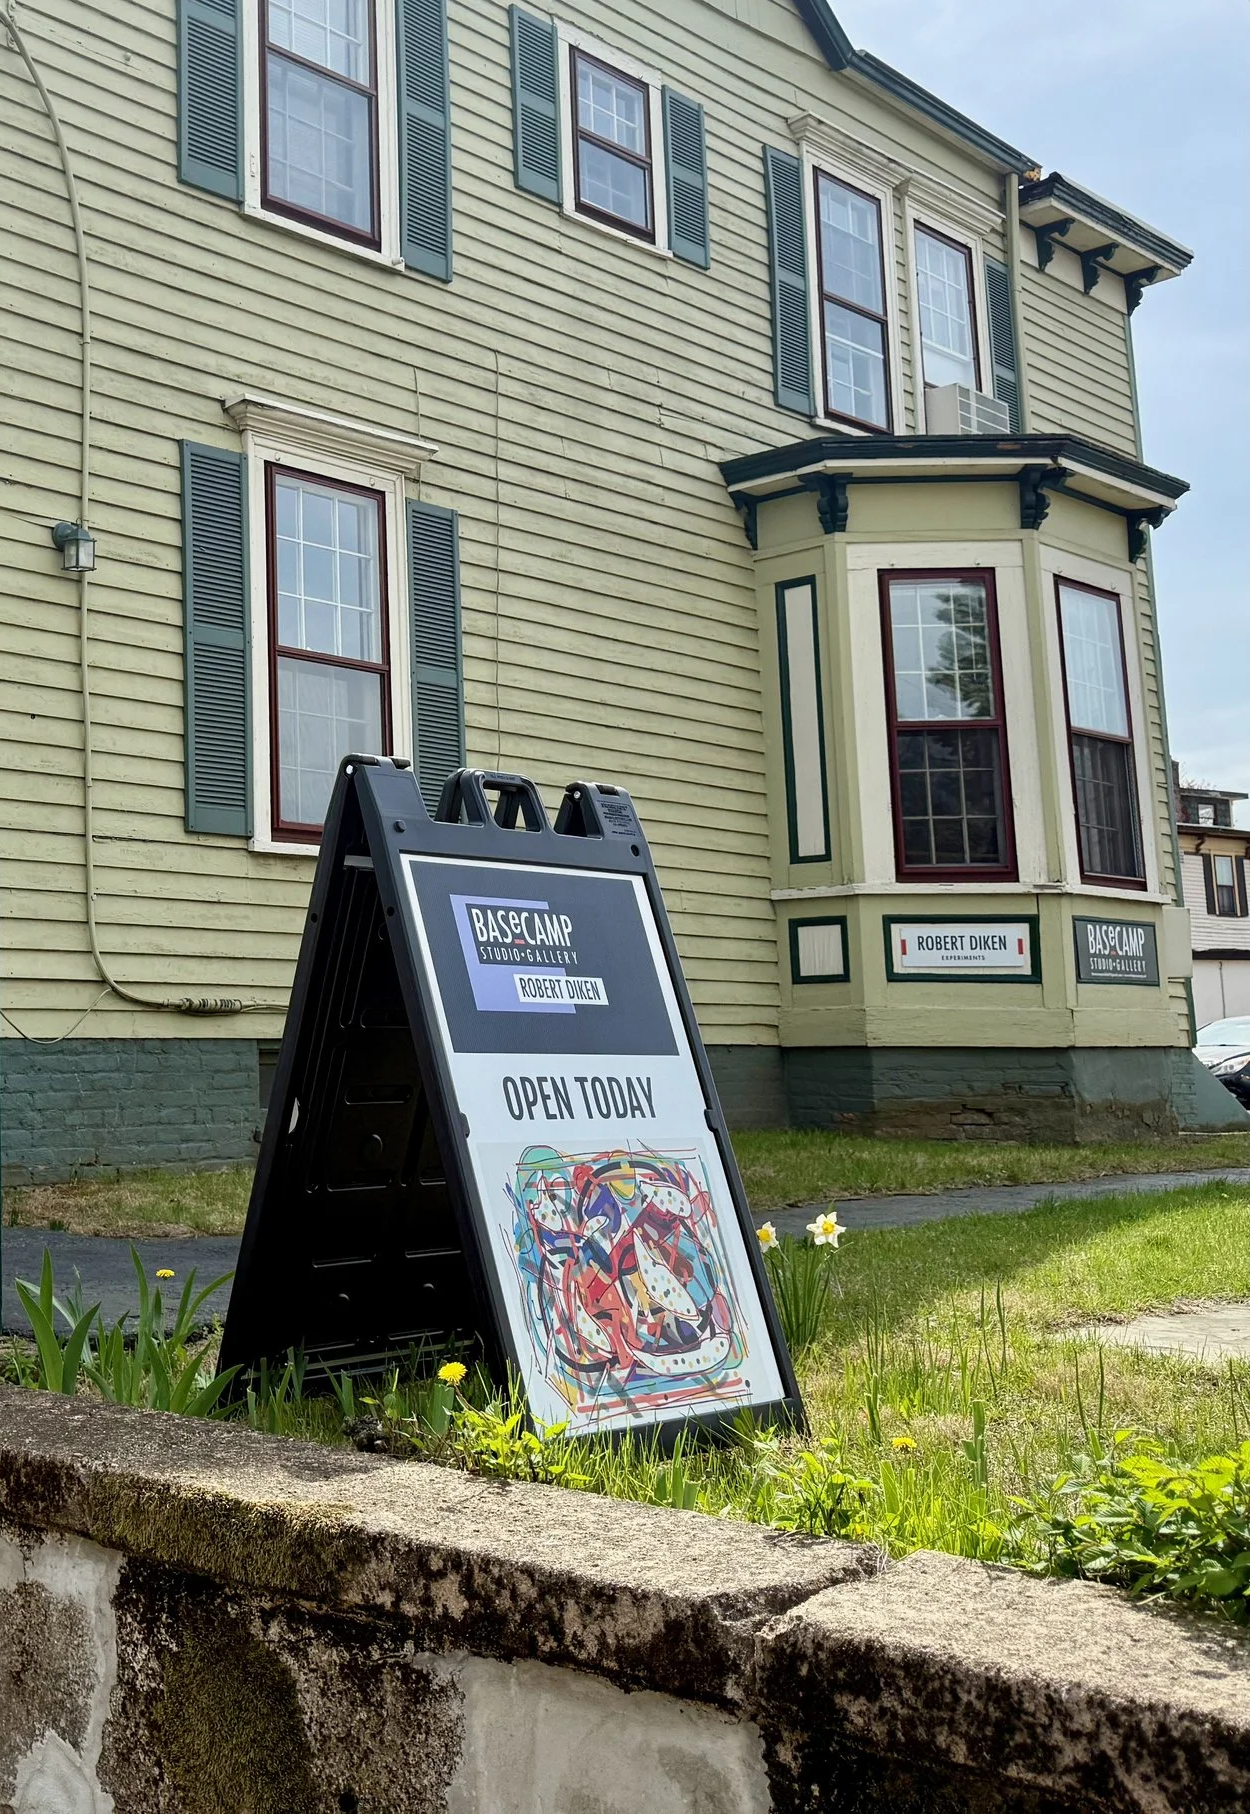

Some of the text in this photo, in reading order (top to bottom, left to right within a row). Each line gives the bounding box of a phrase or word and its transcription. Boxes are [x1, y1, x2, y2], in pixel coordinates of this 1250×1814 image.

[917, 935, 1007, 951] ROBERT DIKEN
[519, 977, 601, 1001] ROBERT DIKEN
[502, 1076, 656, 1121] OPEN TODAY
